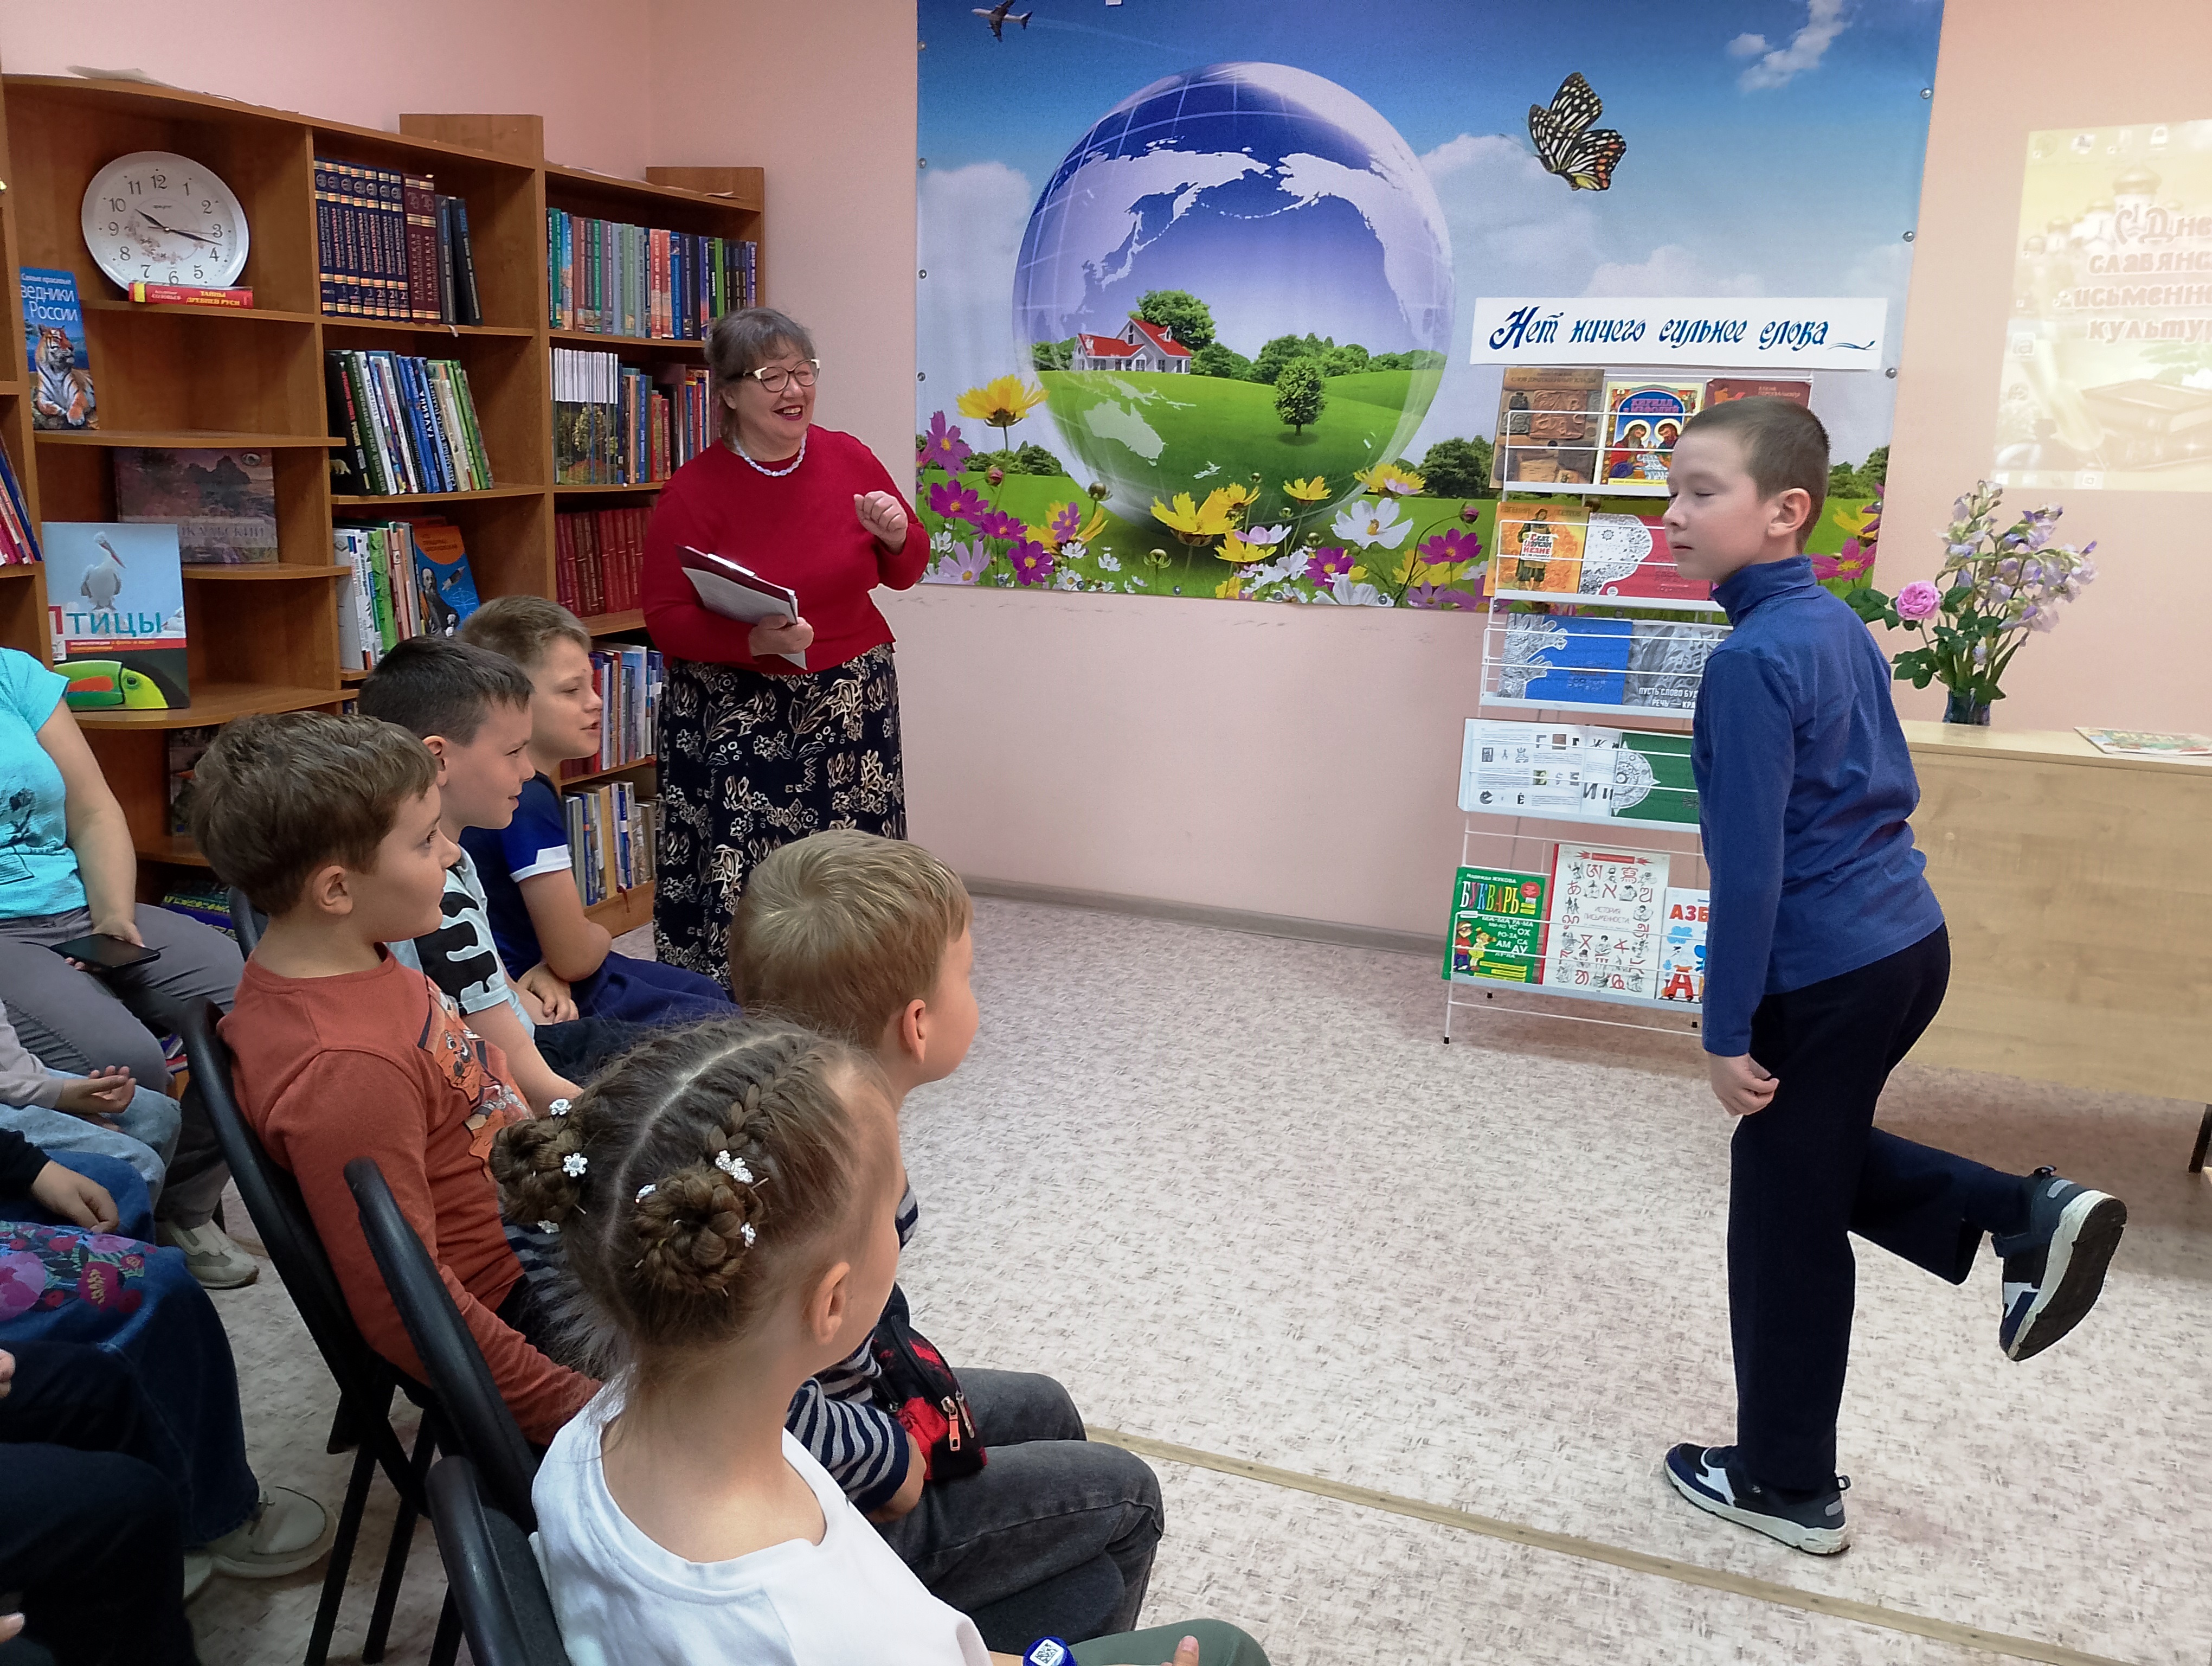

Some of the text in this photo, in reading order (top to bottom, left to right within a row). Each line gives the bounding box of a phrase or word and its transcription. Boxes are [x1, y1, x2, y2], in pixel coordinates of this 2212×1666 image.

[128, 181, 142, 195] 11
[150, 175, 168, 189] 12
[183, 182, 190, 196] 1
[109, 198, 126, 212] 10
[202, 200, 212, 214] 2
[108, 221, 119, 236] 9
[212, 223, 223, 238] 3
[120, 246, 131, 261] 8
[209, 247, 220, 262] 4
[140, 265, 152, 278] 7
[168, 271, 179, 285] 6
[194, 265, 204, 279] 5
[1489, 306, 1829, 351] Нет ничего сильнее слова
[418, 390, 434, 438] ГЛУБИНА
[1639, 687, 1660, 697] ПУСТЬ
[1661, 689, 1683, 697] СЛОВО
[1652, 699, 1669, 707] РЕЧЬ
[1459, 881, 1520, 914] БУКВАРЬ
[1517, 928, 1531, 937] ОХ
[1495, 940, 1512, 949] АМ
